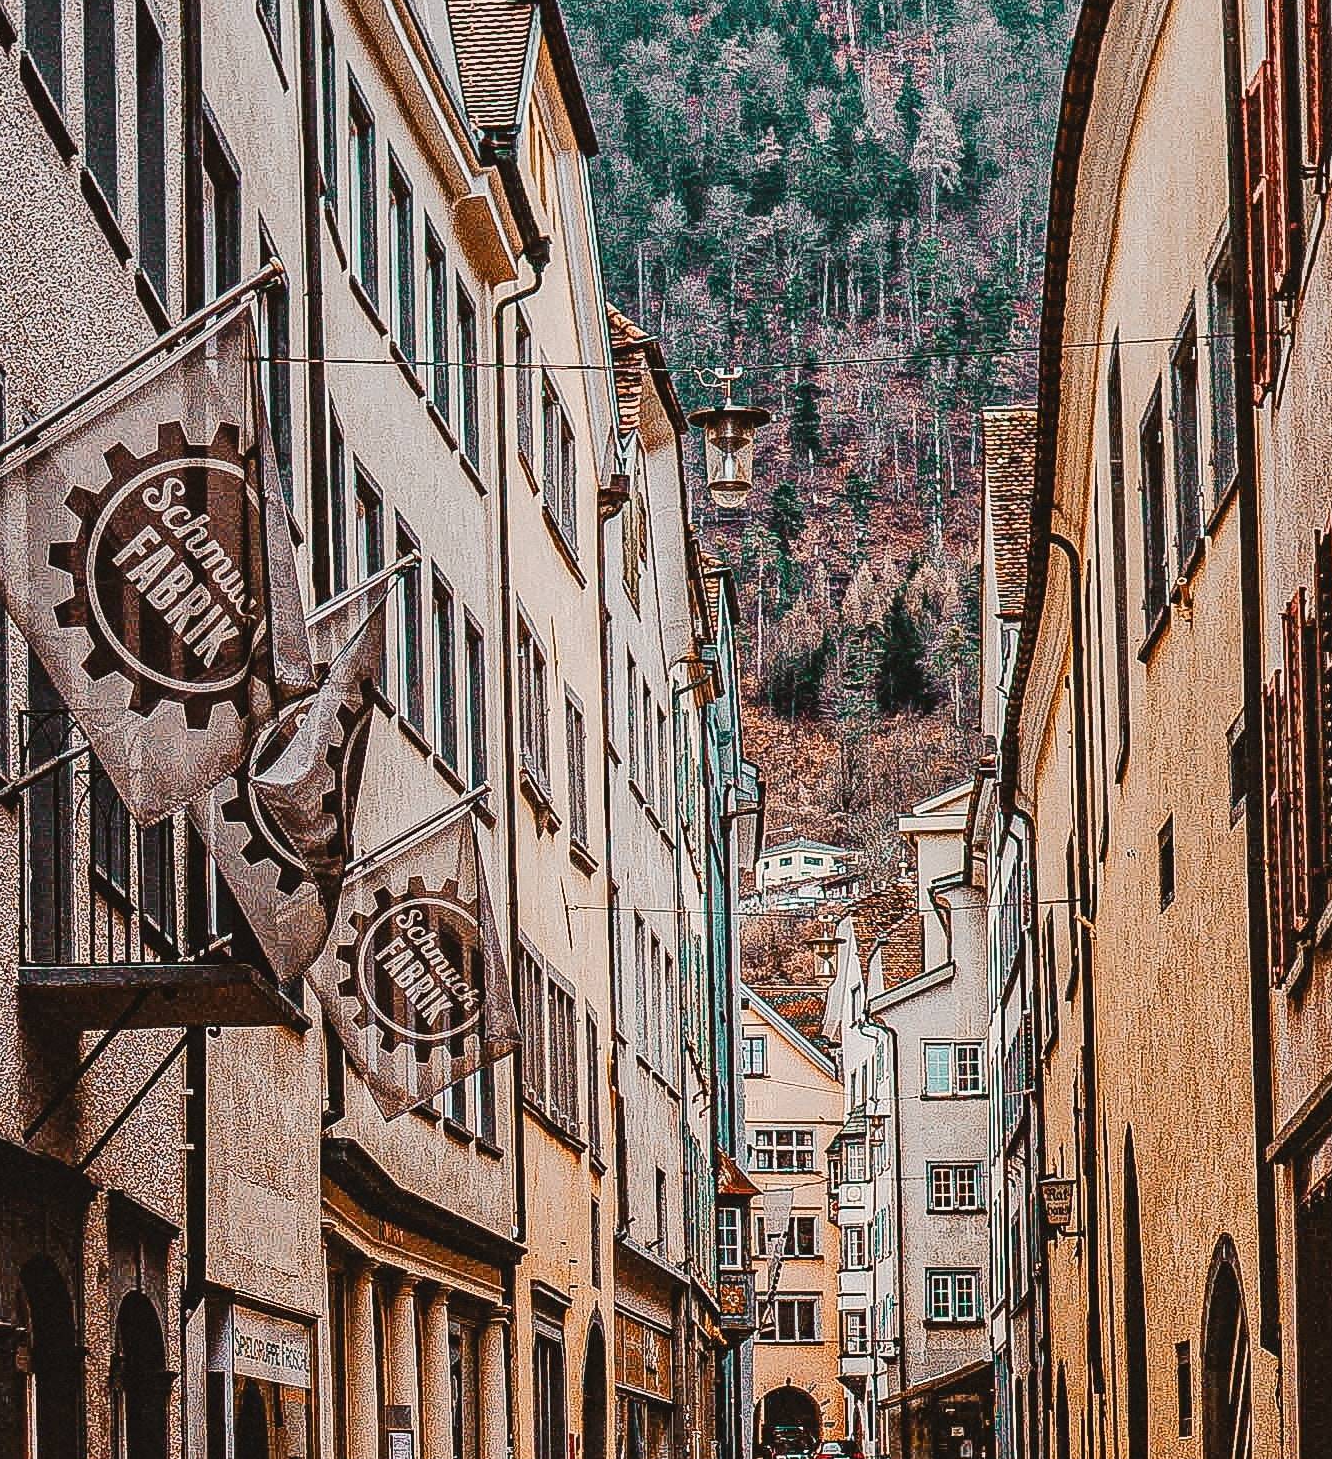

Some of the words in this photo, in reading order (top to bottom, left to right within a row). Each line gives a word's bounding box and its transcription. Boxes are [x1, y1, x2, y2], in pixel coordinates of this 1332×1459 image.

[112, 524, 240, 669] FABRIK
[374, 936, 454, 1027] FABRIK
[395, 909, 480, 1011] Schmuck
